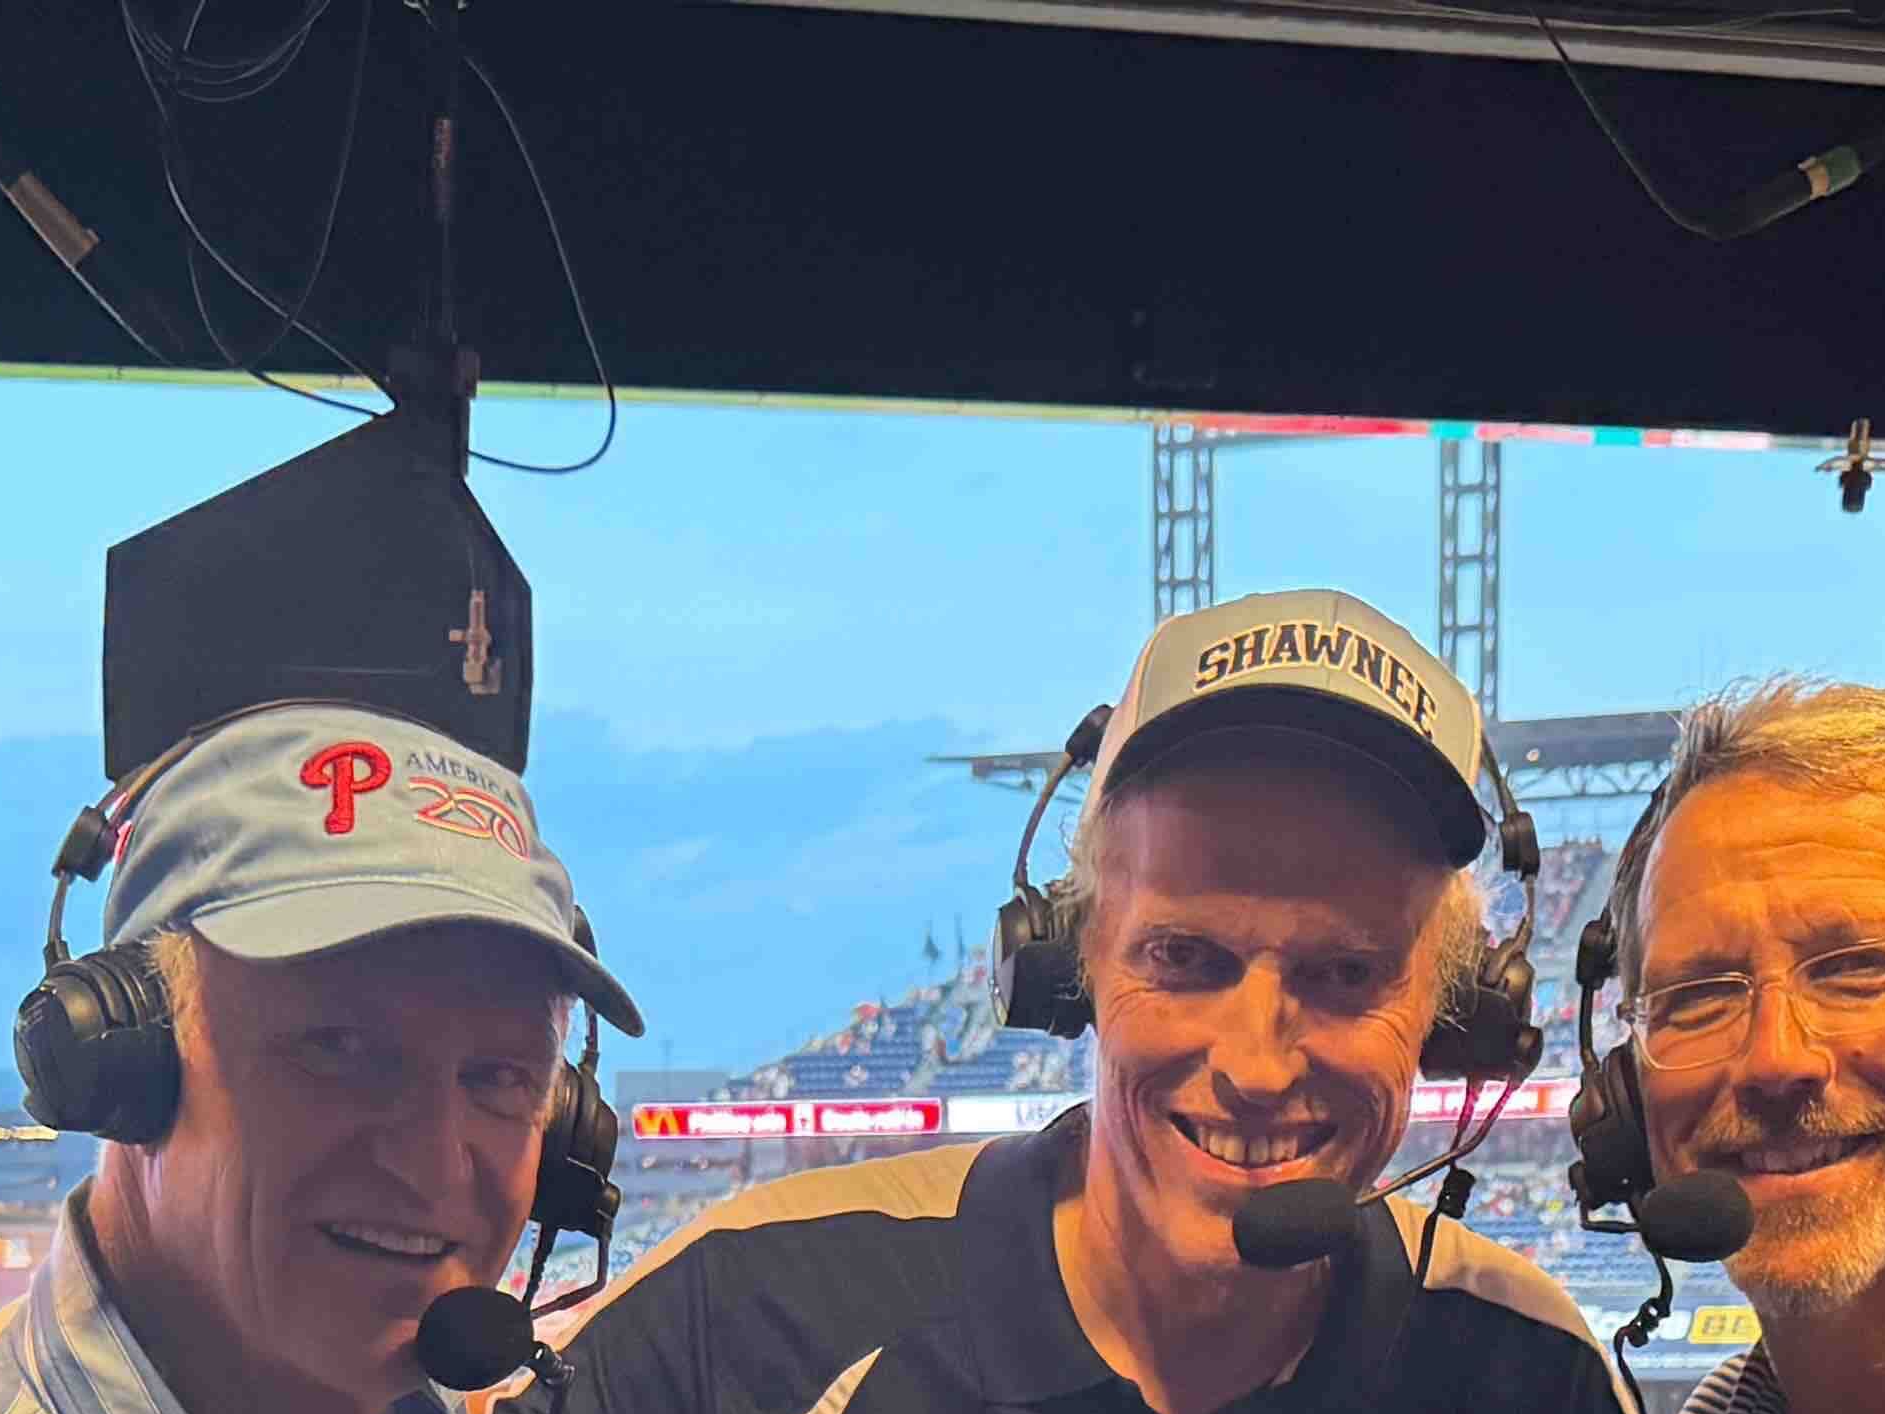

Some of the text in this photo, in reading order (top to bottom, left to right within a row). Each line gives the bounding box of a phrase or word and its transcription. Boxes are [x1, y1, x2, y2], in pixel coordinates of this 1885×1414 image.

[1194, 618, 1439, 742] SHAWNEE
[299, 740, 393, 836] P
[406, 751, 518, 807] AMERICA
